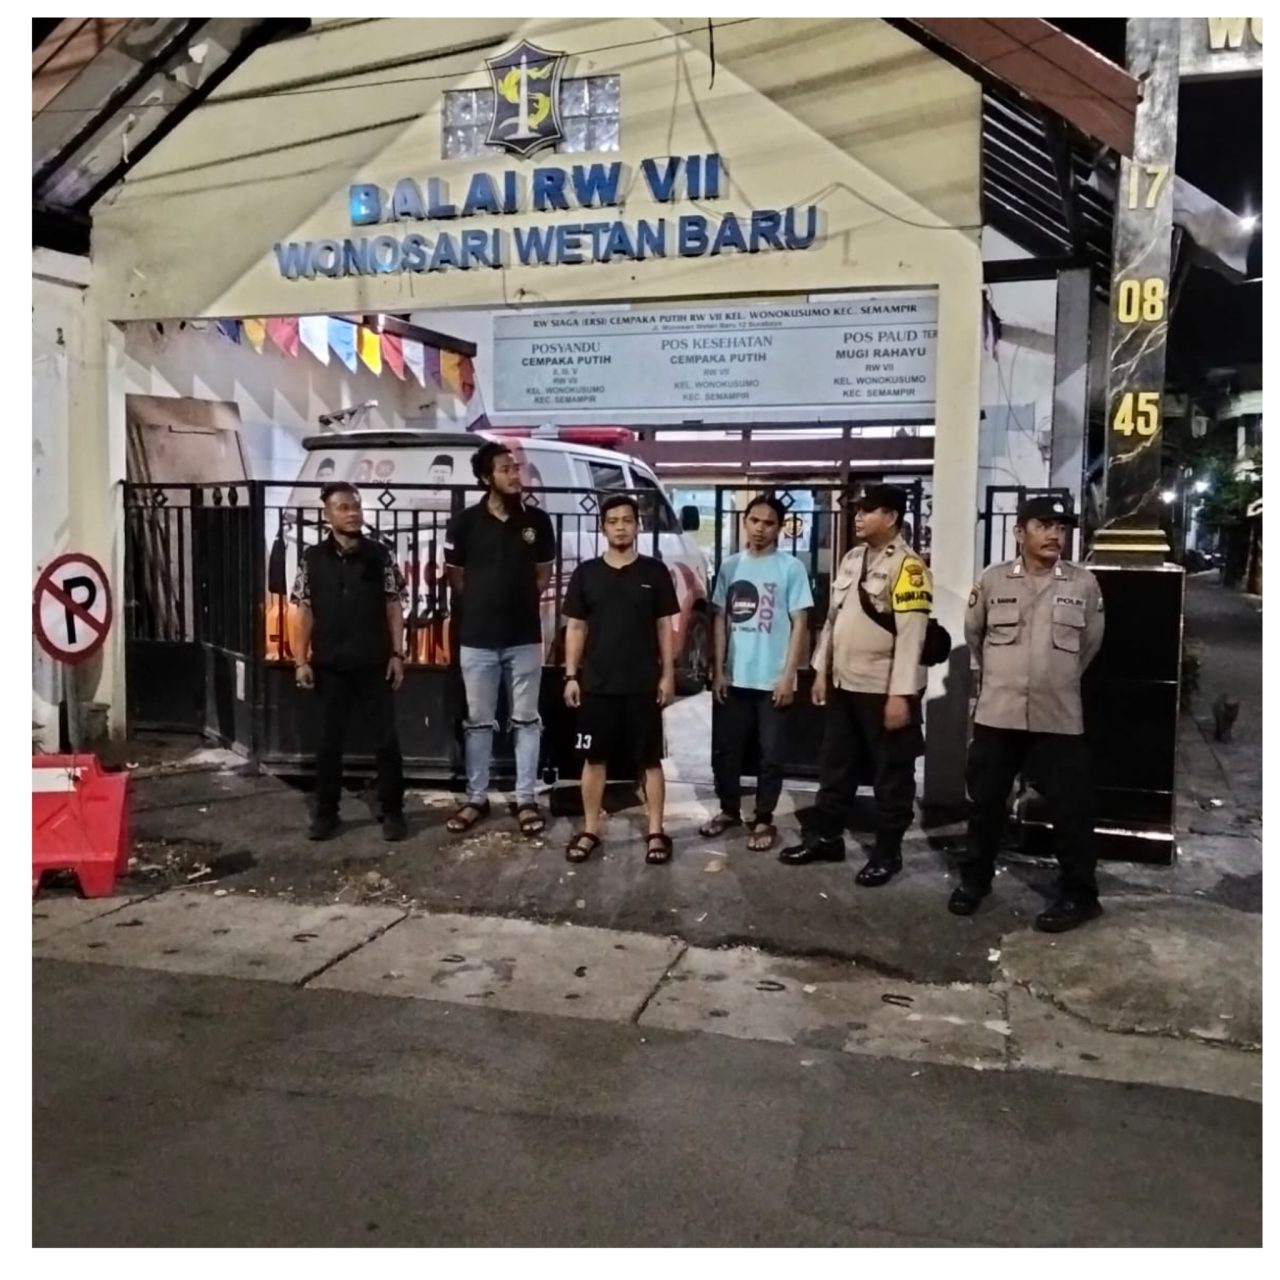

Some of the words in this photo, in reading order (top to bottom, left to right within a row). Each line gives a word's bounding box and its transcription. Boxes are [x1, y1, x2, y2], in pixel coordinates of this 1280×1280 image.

[350, 169, 518, 225] BALAI
[532, 161, 625, 212] RW
[642, 153, 721, 205] VII
[1127, 166, 1168, 210] 17
[274, 228, 503, 280] WONOSARI
[513, 217, 667, 265] WETAN
[678, 205, 818, 256] BARU
[1117, 277, 1165, 324] 08
[550, 318, 579, 327] SIAGA
[609, 315, 656, 325] CEMPAKA
[659, 314, 687, 323] PUTIH
[689, 313, 706, 322] RW
[749, 307, 831, 319] WONOKUSUMO
[860, 304, 918, 315] SEMAMPIR
[661, 338, 689, 350] POS
[692, 335, 773, 350] KESEHATAN
[843, 331, 874, 344] POS
[877, 329, 918, 342] PAUD
[531, 341, 600, 354] POSYANDU
[835, 348, 869, 359] MUGI
[873, 347, 927, 358] RAHAYU
[521, 356, 574, 367] CEMPAKA
[577, 355, 612, 365] PUTIH
[669, 354, 726, 365] CEMPAKA
[729, 352, 767, 362] PUTIH
[865, 363, 881, 372] RW
[694, 378, 760, 389] WONOKUSUMO
[855, 375, 927, 385] WONOKUSUMO
[545, 385, 606, 394] WONOKUSUMO
[704, 391, 750, 401] SEMAMPIR
[866, 388, 916, 398] SEMAMPIR
[554, 395, 597, 404] SEMAMPIR
[1112, 391, 1160, 436] 45
[757, 581, 778, 634] 2024
[574, 732, 592, 750] 13
